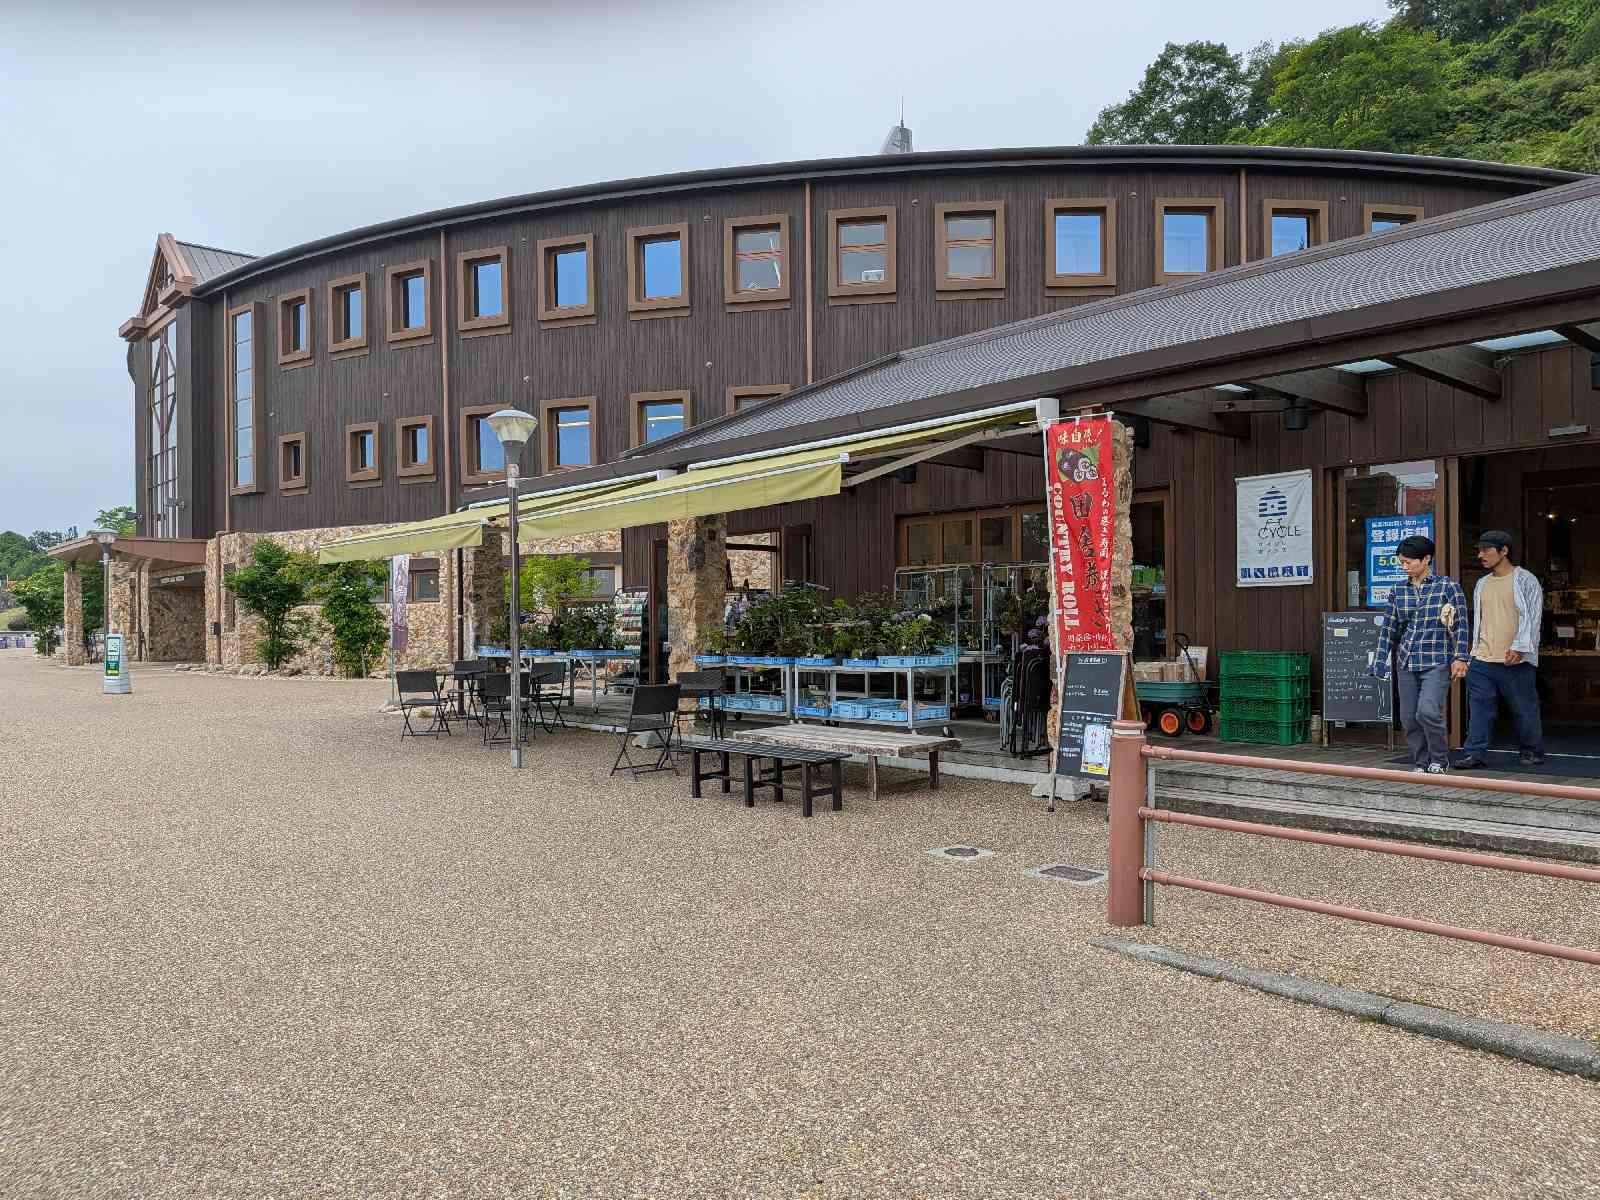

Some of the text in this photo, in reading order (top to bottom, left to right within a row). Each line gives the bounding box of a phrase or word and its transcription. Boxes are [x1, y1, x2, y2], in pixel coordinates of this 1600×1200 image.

[1053, 481, 1080, 632] COUNTRY ROLL
[1258, 525, 1304, 539] CYCLE
